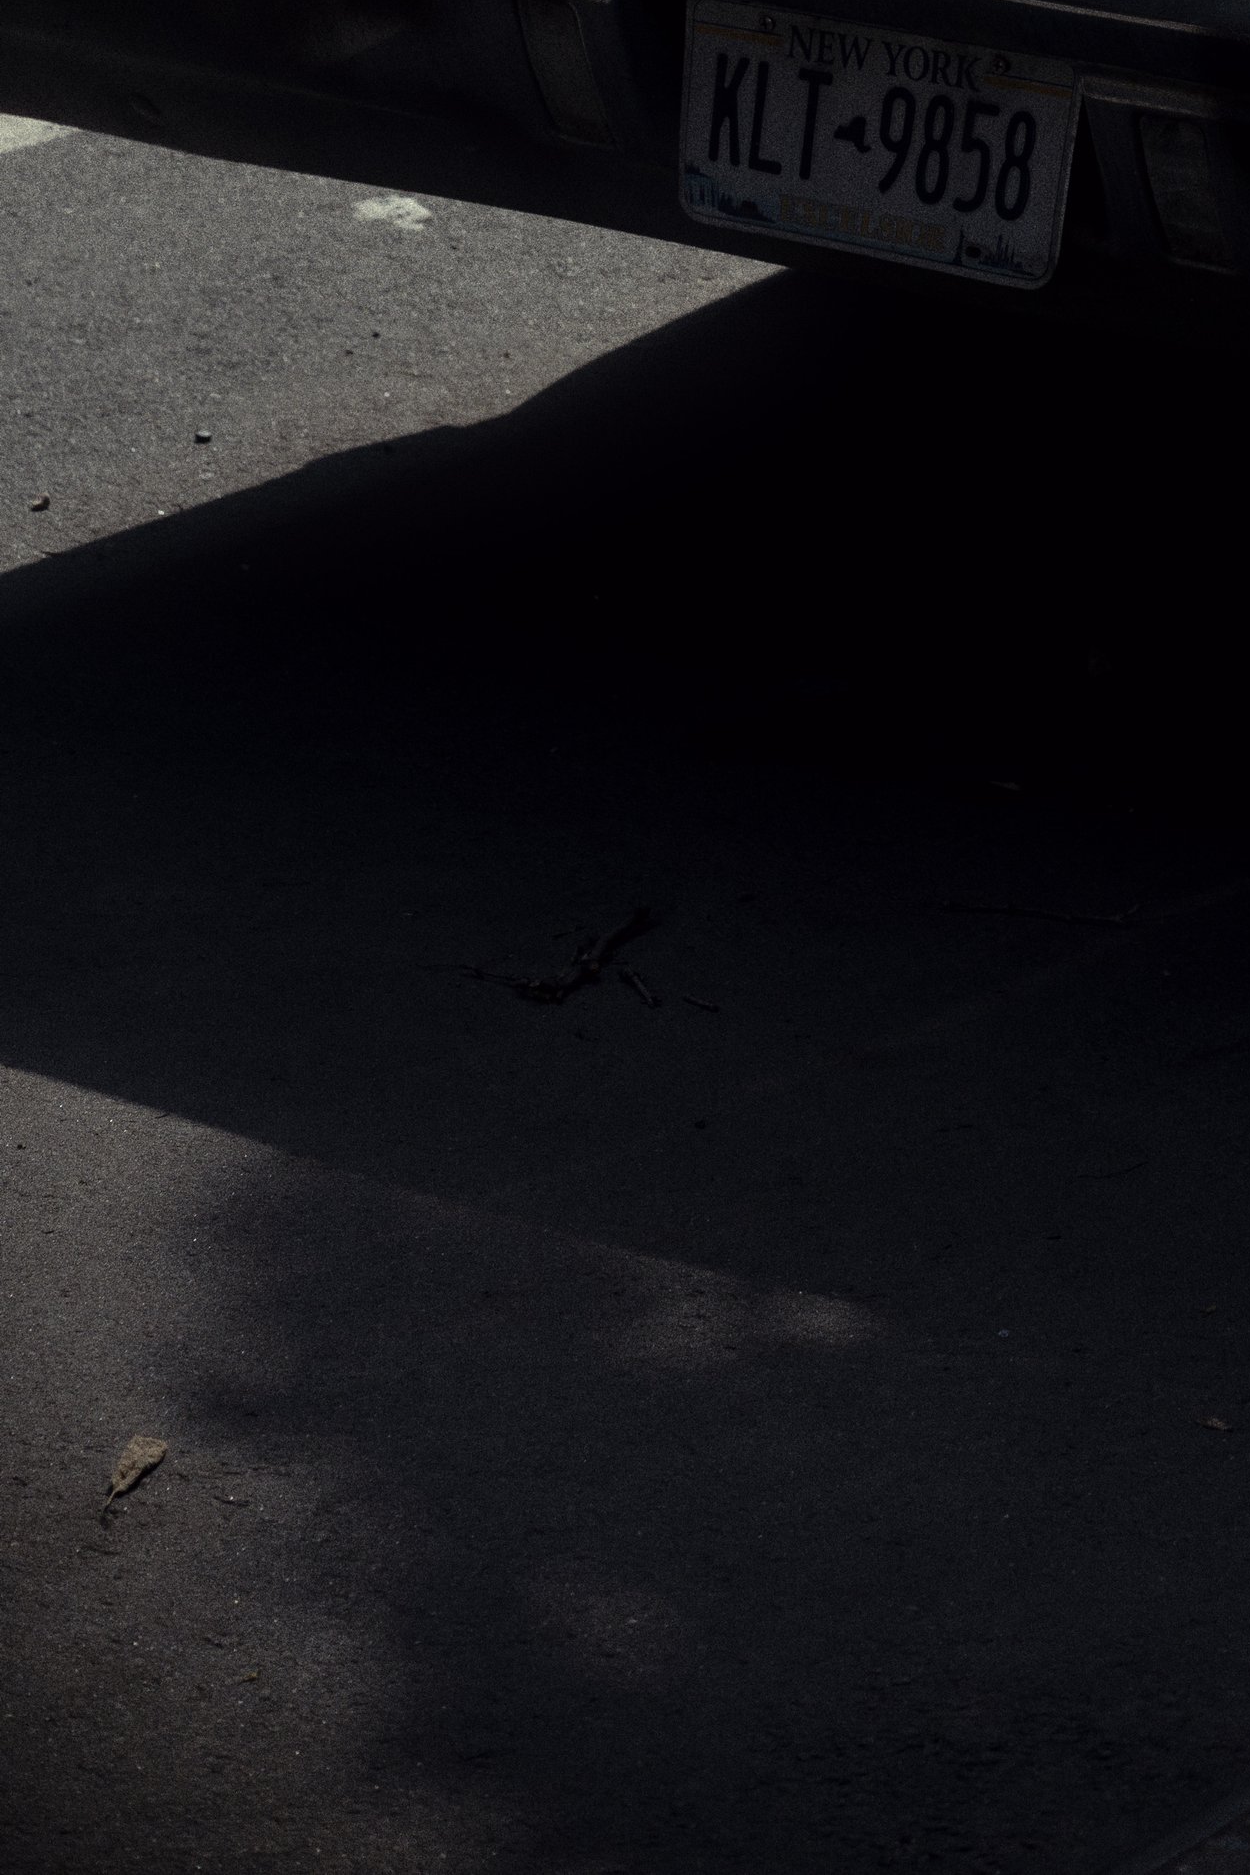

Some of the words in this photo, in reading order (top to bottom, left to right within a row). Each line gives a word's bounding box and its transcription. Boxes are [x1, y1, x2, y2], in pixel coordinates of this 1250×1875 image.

[787, 25, 872, 71] NEW
[881, 40, 983, 92] YORK
[708, 52, 833, 180] KLT
[878, 85, 1037, 221] 9858
